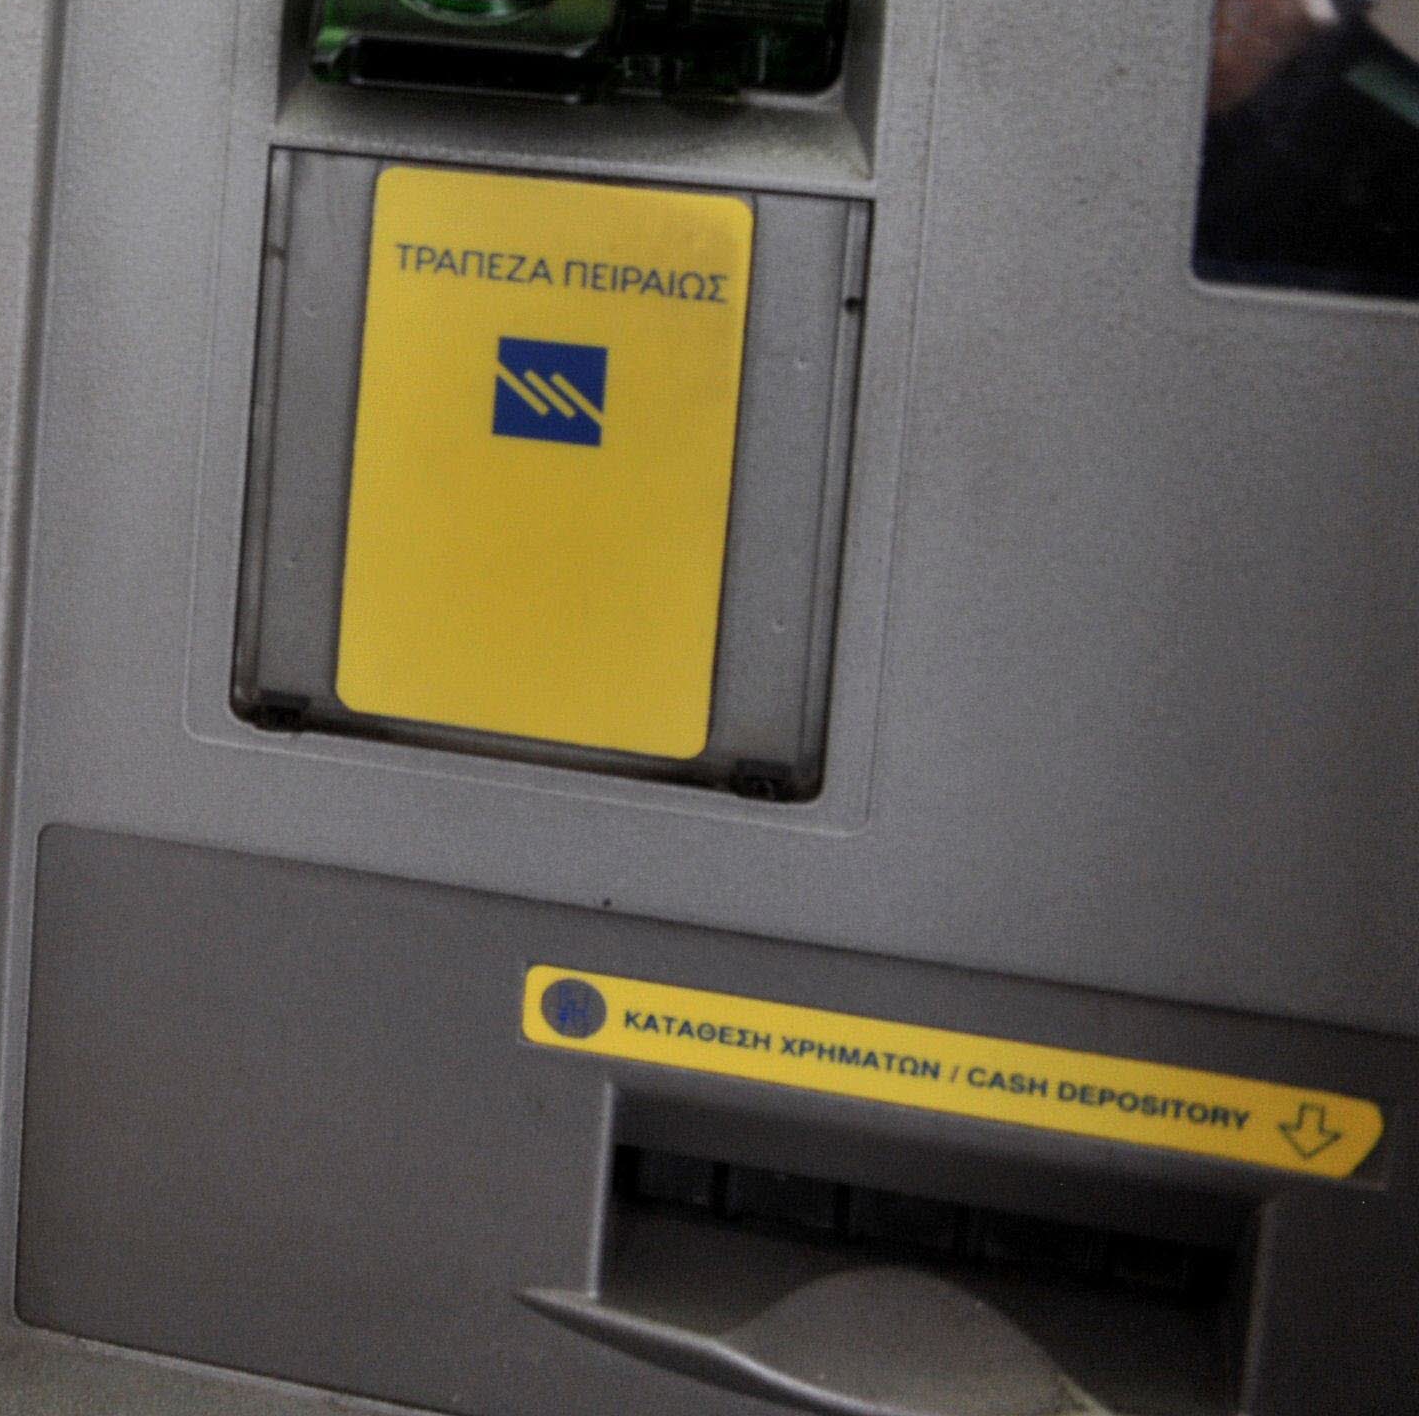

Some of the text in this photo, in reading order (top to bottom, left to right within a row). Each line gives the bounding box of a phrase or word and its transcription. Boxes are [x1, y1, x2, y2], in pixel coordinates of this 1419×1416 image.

[396, 242, 729, 304] ΤΡΑΠΕΖΑ ΠΕΙΡΑΙΩΣ
[622, 1009, 1252, 1131] ΚΑΤΑΘΕΣΗ ΧΡΗΜΑΤΩΝ / CASH DEPOSITORY
